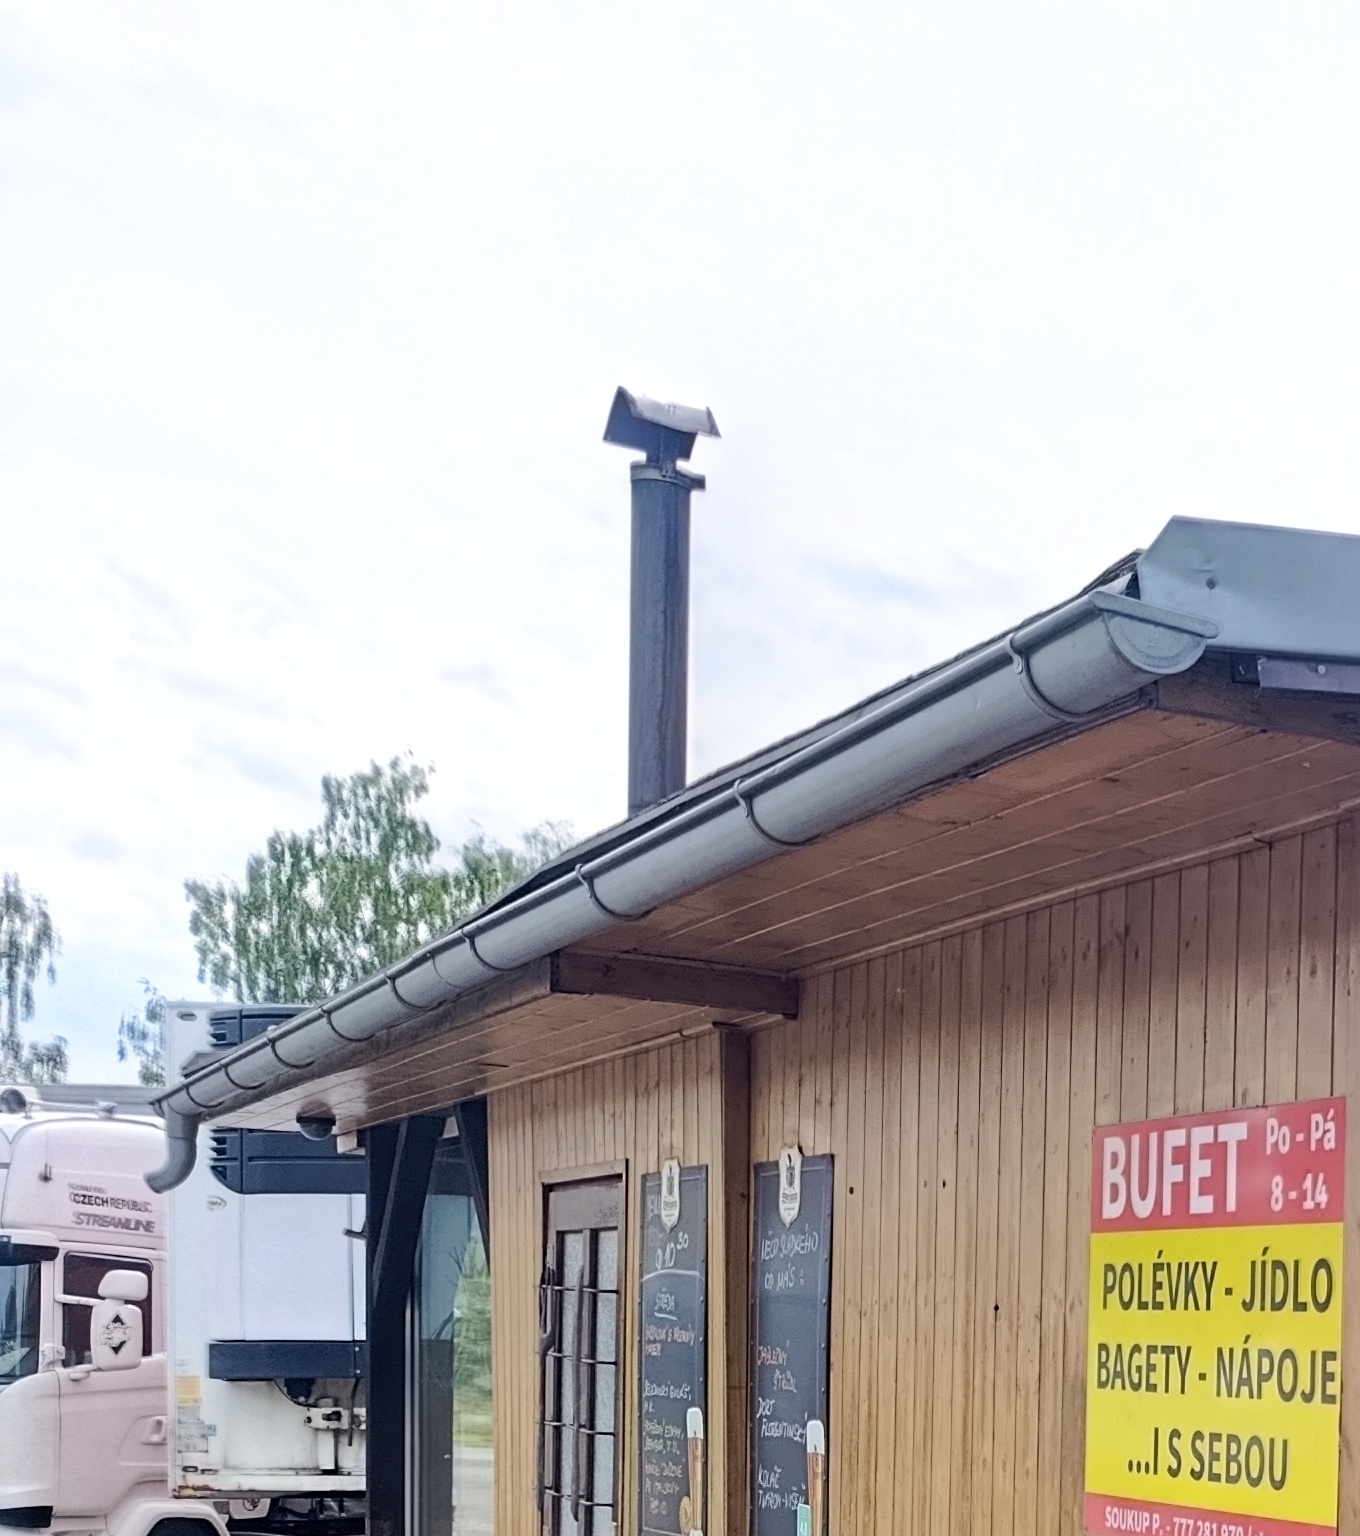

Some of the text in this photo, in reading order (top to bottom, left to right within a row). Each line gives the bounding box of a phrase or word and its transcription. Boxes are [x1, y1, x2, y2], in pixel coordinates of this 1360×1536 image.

[1266, 1118, 1290, 1155] Po
[1310, 1108, 1336, 1151] Pá
[1102, 1121, 1248, 1220] BUFET
[1270, 1175, 1284, 1212] 8
[1302, 1172, 1329, 1211] 14
[73, 1193, 153, 1214] CZECH REPUBLIC
[73, 1212, 156, 1234] STREAMLINE
[1102, 1250, 1218, 1312] POLÉVKY
[1241, 1246, 1334, 1315] JÍDLO
[1097, 1342, 1193, 1395] BAGETY
[1216, 1334, 1338, 1406] NÁPOJE
[1167, 1430, 1182, 1479] S
[1190, 1430, 1289, 1491] SEBOU
[1105, 1506, 1150, 1535] SOUKUP
[1152, 1513, 1164, 1536] P.
